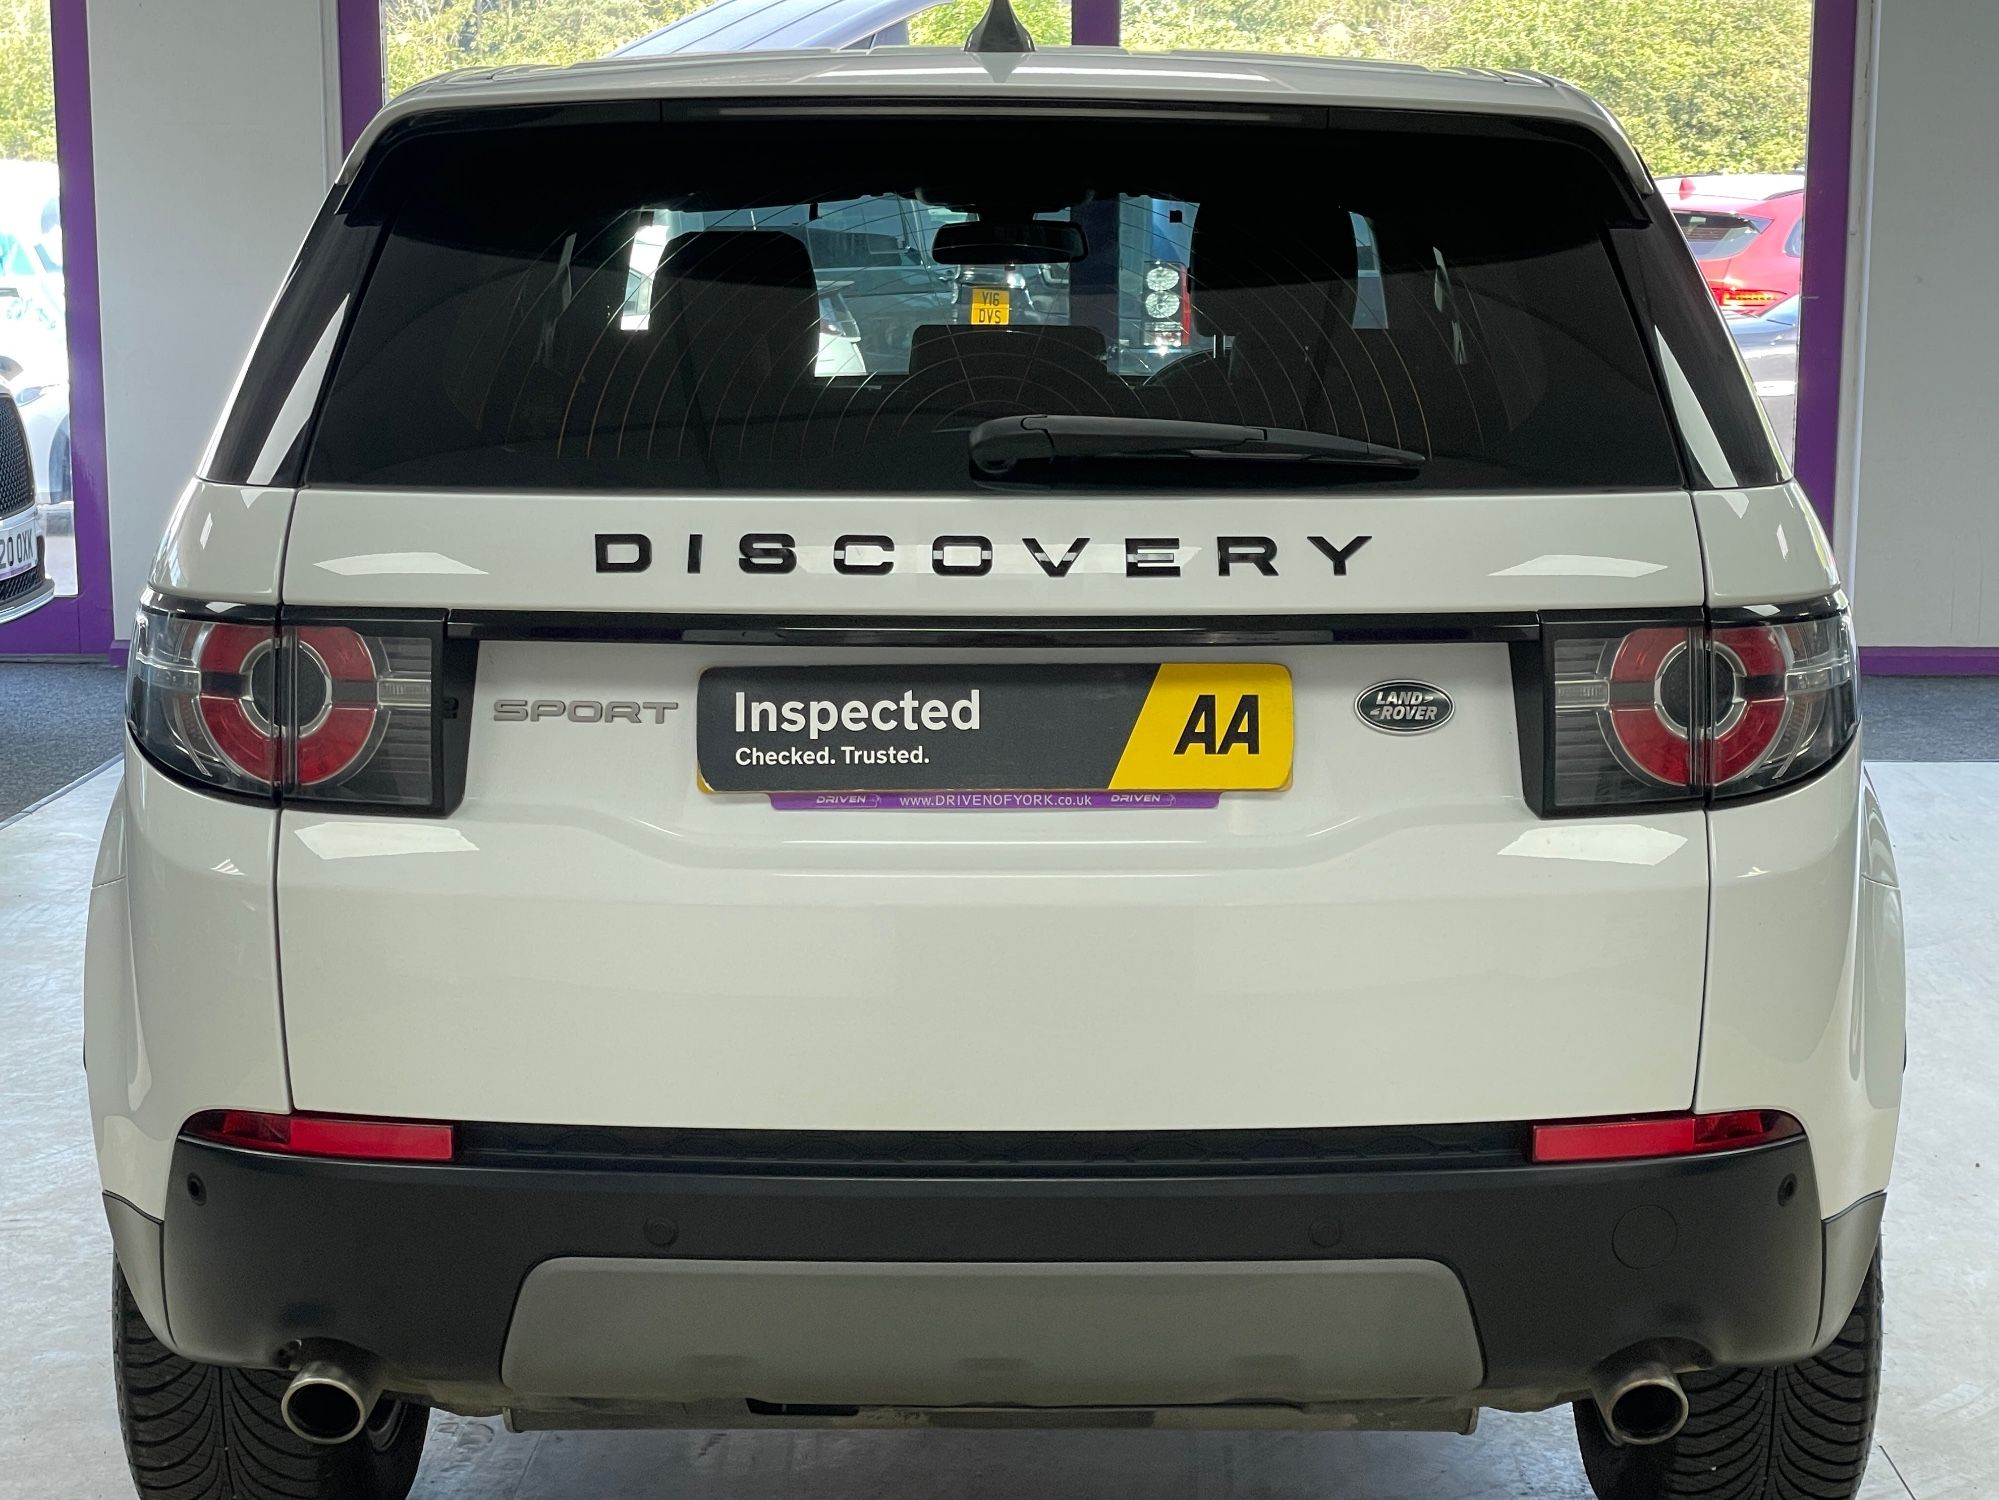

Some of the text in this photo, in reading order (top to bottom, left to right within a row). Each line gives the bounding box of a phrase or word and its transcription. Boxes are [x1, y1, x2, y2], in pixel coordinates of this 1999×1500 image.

[979, 309, 1001, 323] DVS
[594, 533, 1373, 577] DISCOVERY
[1376, 691, 1422, 704] LAND
[493, 699, 679, 724] SPORT
[734, 689, 981, 740] Inspected
[1380, 706, 1438, 720] ROVER
[1173, 694, 1261, 756] AA
[735, 744, 930, 766] Checked. Trusted.
[815, 793, 1161, 807] DRIVEN www.DRIVENOFYORK.co.uk DRIVEN
